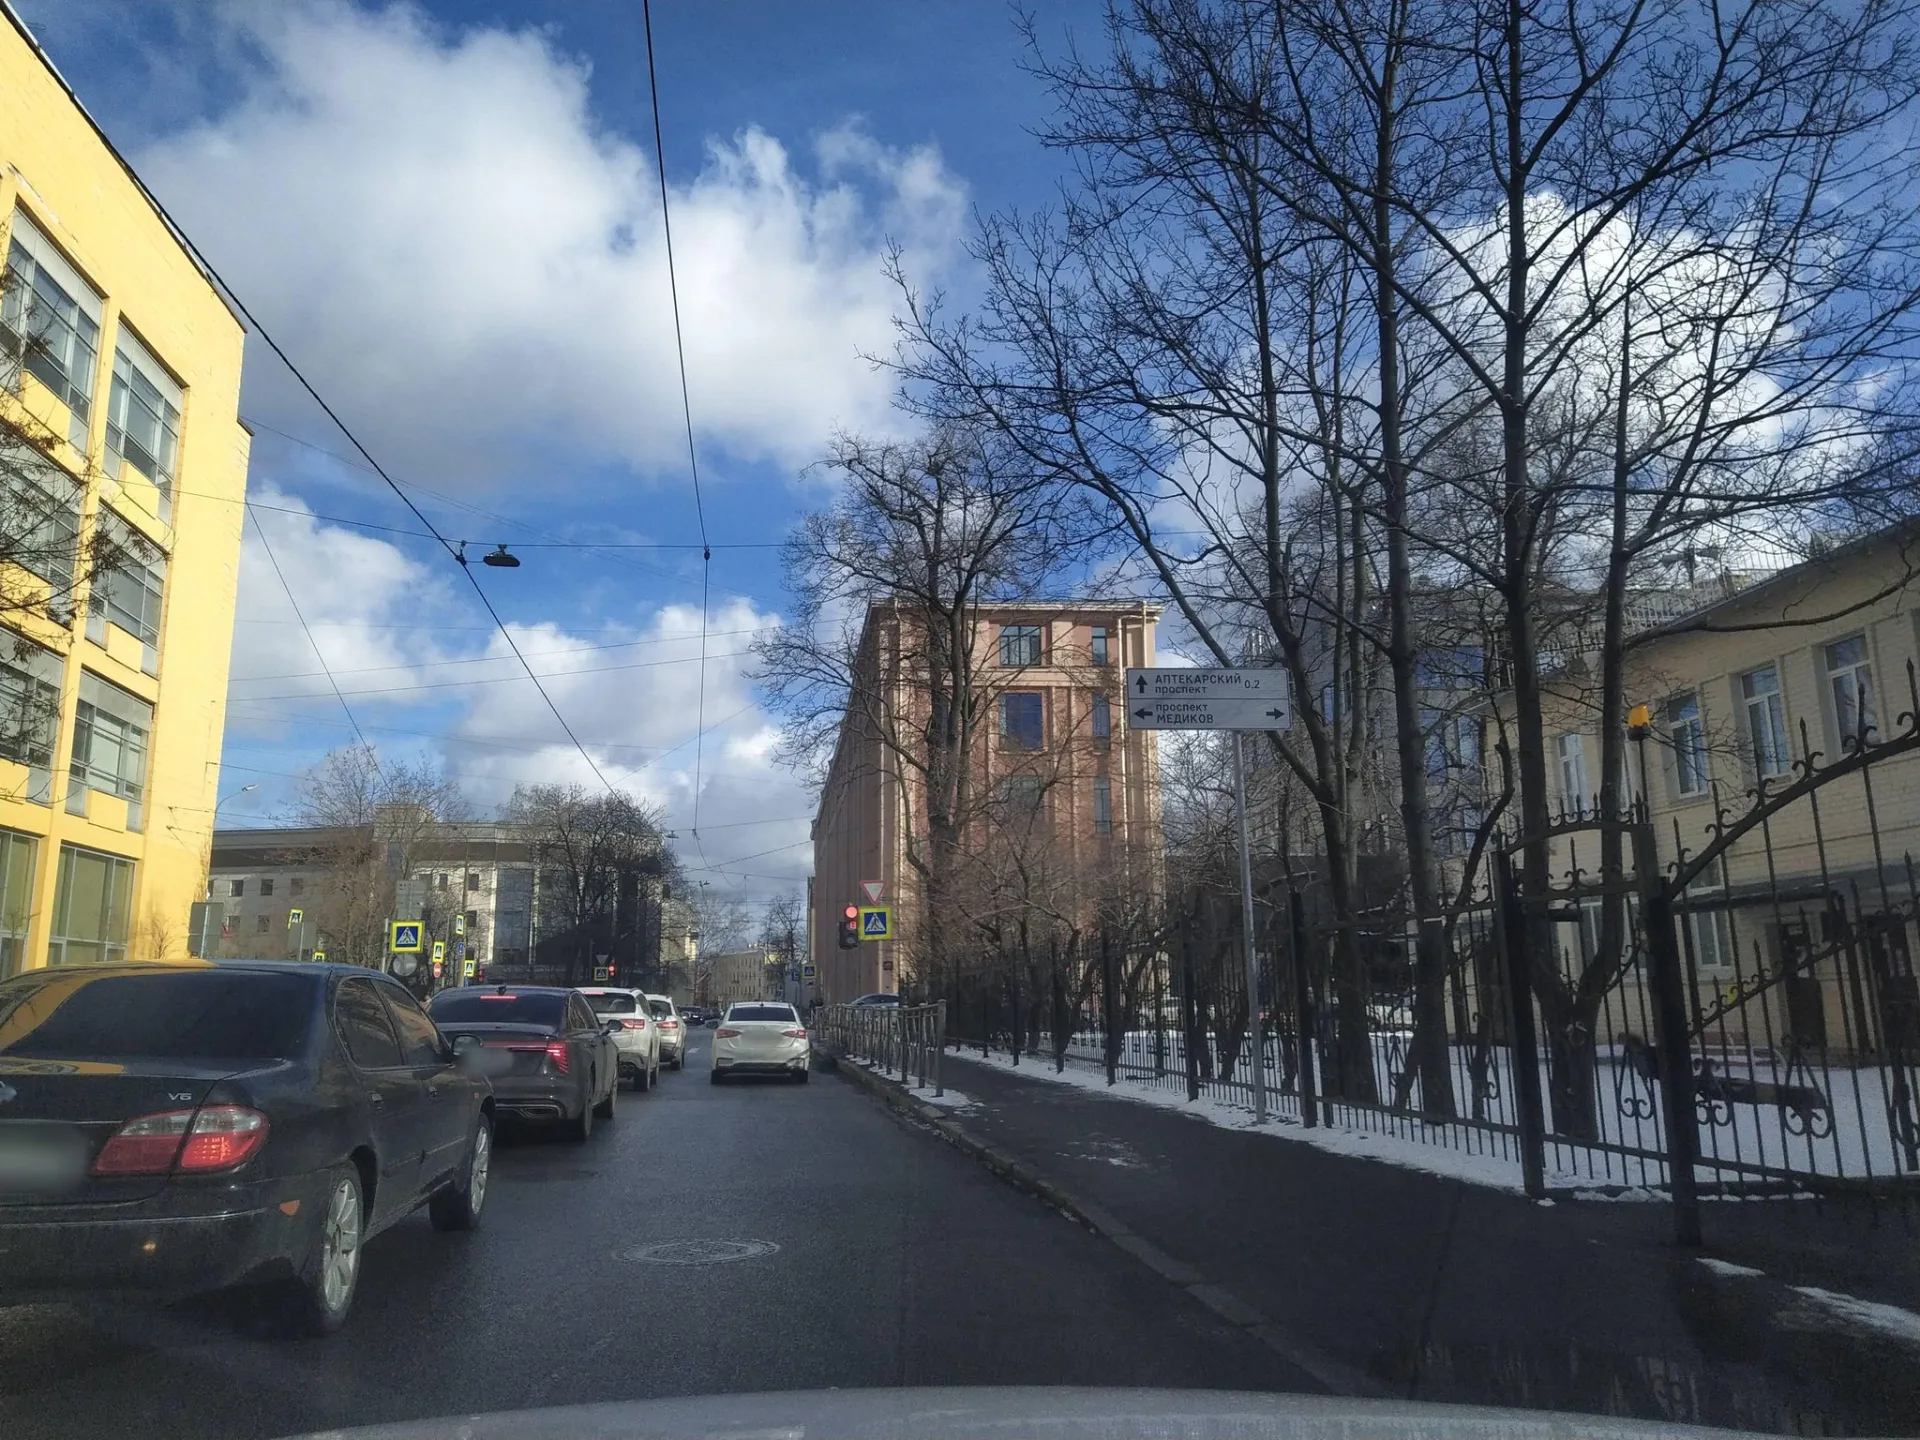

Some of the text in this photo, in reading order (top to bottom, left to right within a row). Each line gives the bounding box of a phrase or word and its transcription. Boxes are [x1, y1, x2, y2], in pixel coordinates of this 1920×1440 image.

[1155, 673, 1241, 684] АПТЕКАРСКИЙ
[1244, 680, 1260, 689] 0.2
[1155, 686, 1207, 695] проспект
[1156, 703, 1208, 712] проспект
[1156, 714, 1214, 724] МЕДИКОВ
[167, 1092, 192, 1101] V6
